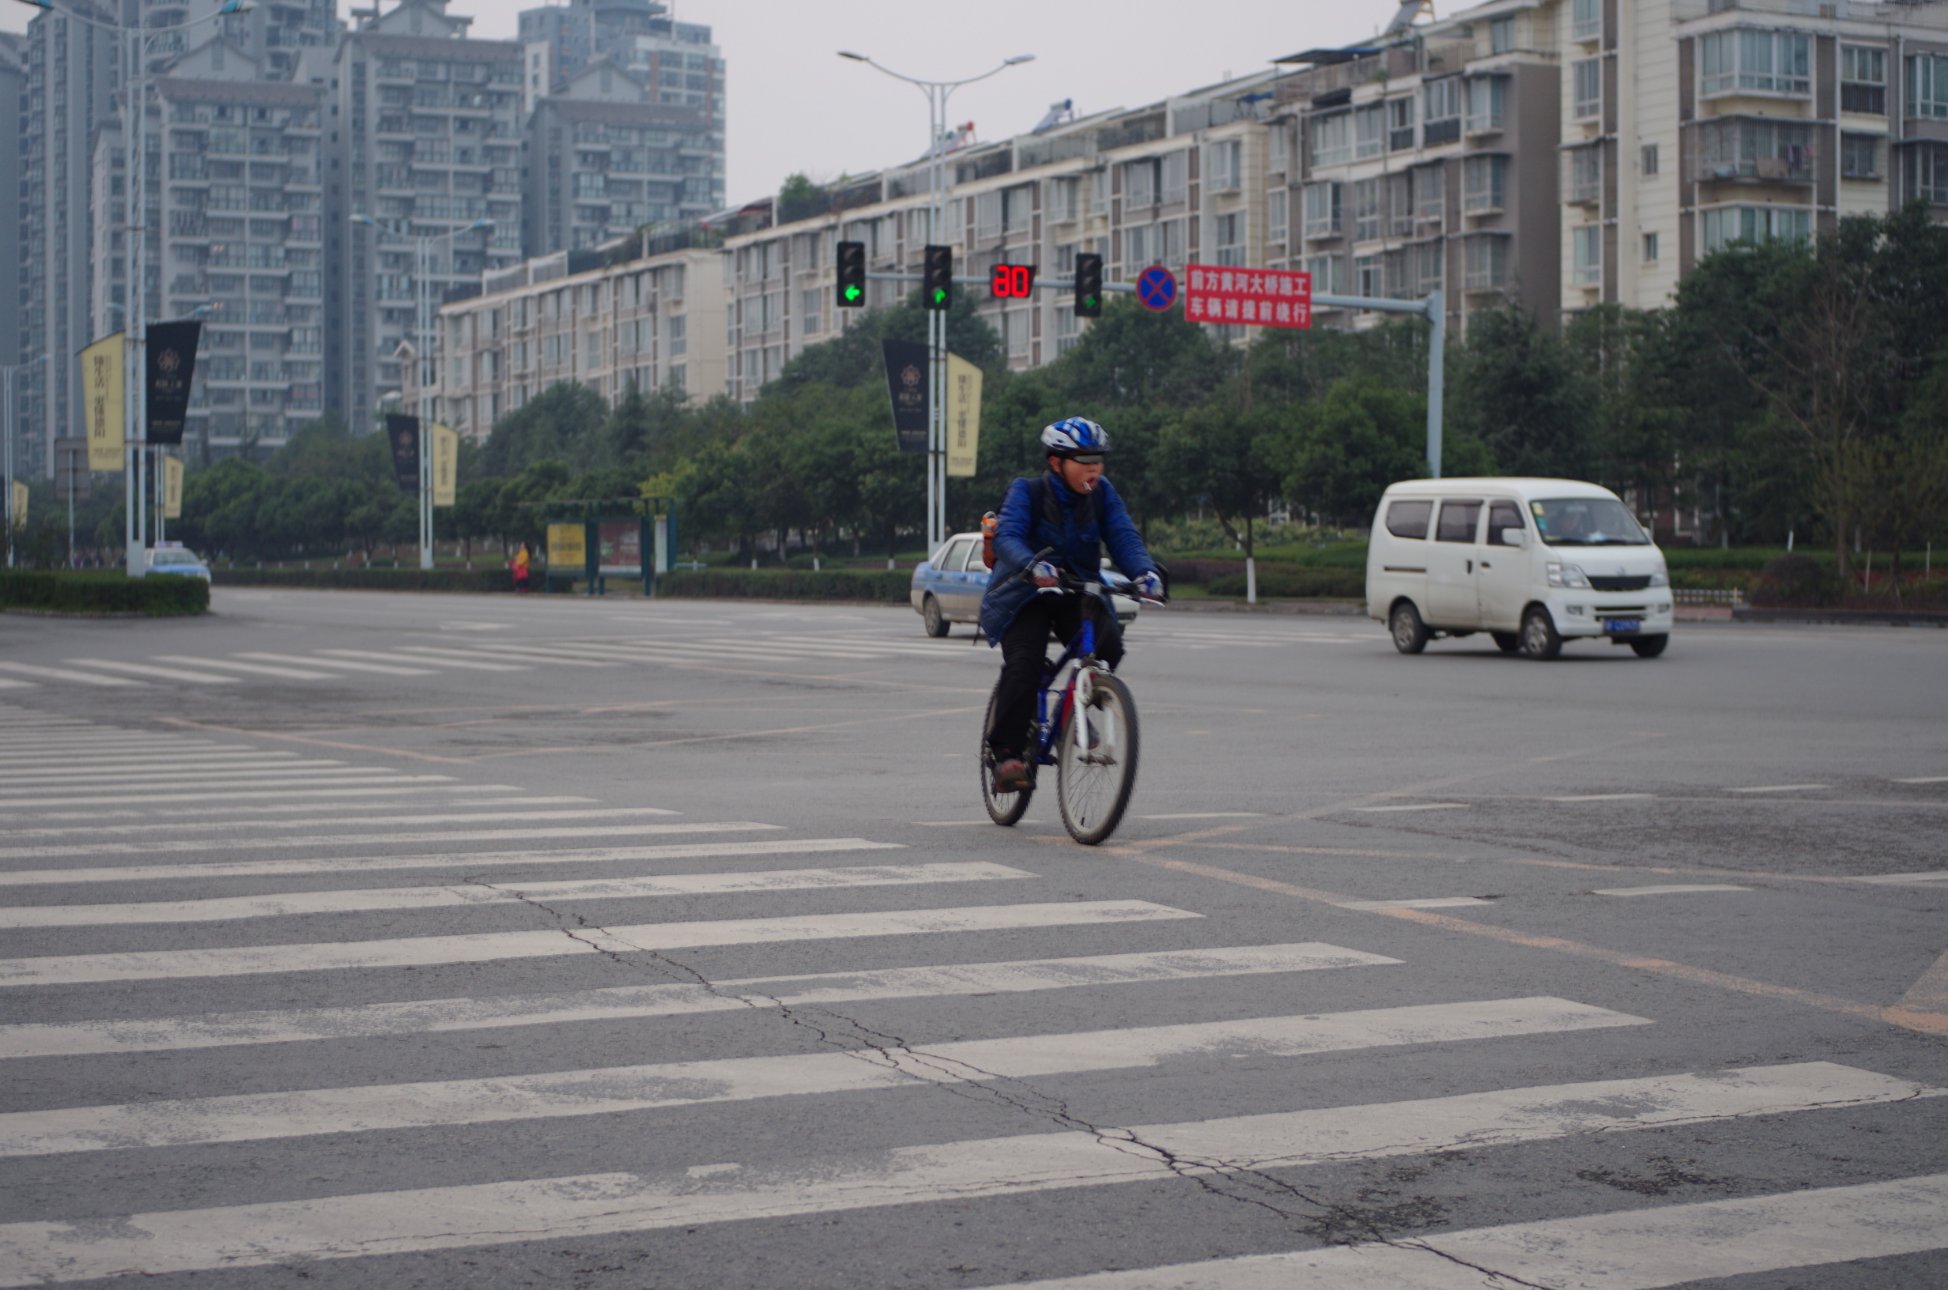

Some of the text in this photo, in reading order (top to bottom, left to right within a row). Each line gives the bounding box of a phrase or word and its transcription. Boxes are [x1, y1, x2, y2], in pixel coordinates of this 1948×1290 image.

[1190, 269, 1307, 296] 前方黄河大桥施工
[1190, 296, 1307, 323] 车辆请提前绕行
